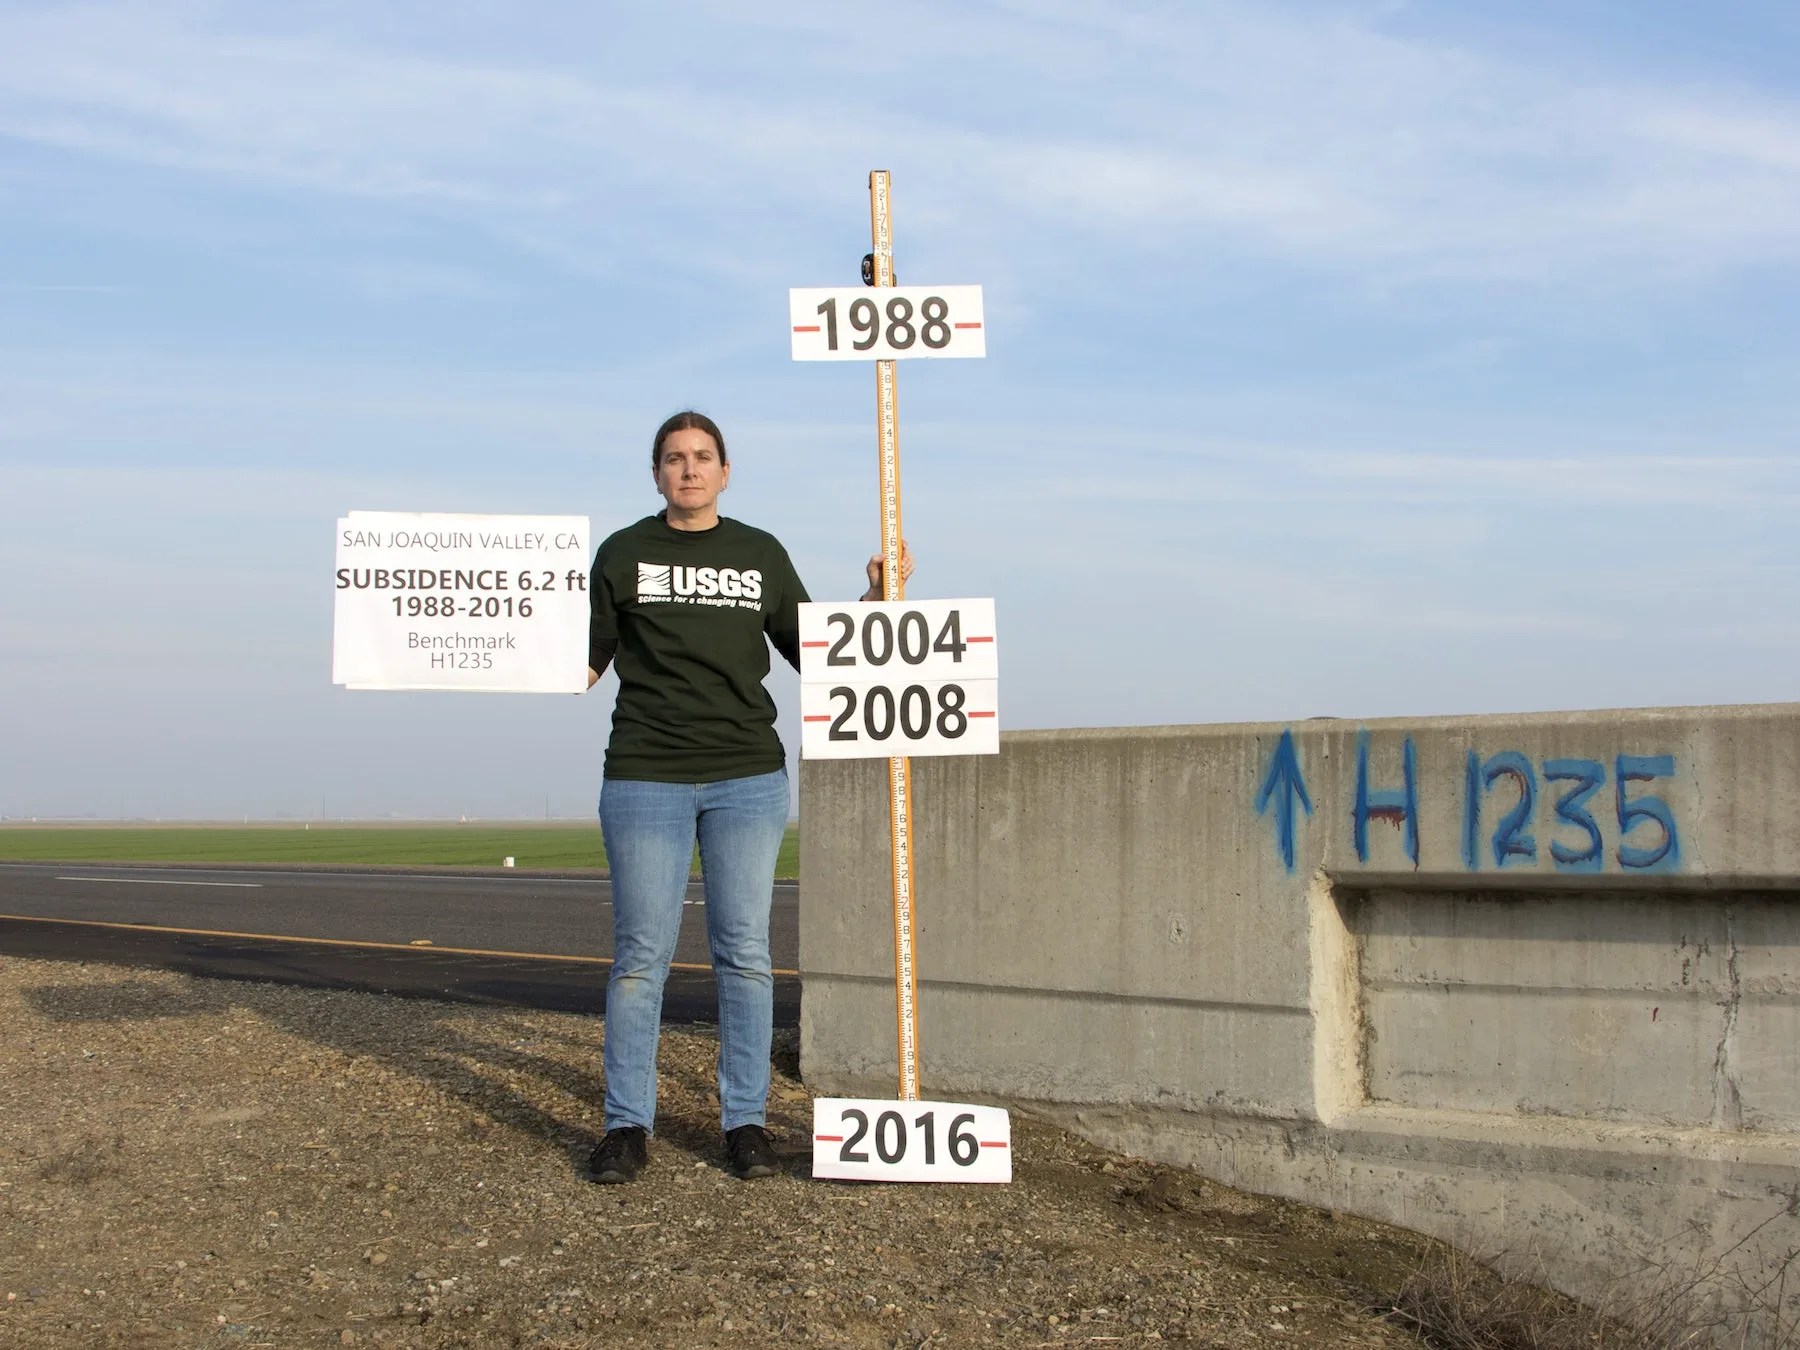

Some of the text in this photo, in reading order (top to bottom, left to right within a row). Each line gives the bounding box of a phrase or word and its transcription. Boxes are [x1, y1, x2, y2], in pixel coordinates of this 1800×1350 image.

[817, 296, 952, 351] 1988
[886, 428, 892, 437] 4
[887, 441, 894, 451] 3
[887, 455, 894, 465] 2
[889, 496, 896, 506] 9
[889, 510, 896, 519] 8
[889, 524, 896, 533] 7
[343, 530, 580, 552] SAN JOAQUIN VALLEY, CA
[890, 538, 897, 547] 6
[890, 551, 897, 560] 5
[891, 565, 897, 574] 4
[336, 568, 587, 591] SUBSIDENCE 6.2 ft
[673, 565, 762, 600] USGS
[392, 595, 533, 618] 1988-2016
[637, 593, 763, 612] science for a changing world
[408, 631, 516, 649] Benchmark
[827, 610, 967, 667] 2004
[431, 652, 493, 669] H1235
[829, 684, 968, 741] 2008
[898, 772, 905, 781] 9
[899, 800, 906, 809] 7
[899, 814, 906, 823] 6
[900, 828, 907, 837] 5
[901, 842, 906, 851] 4
[901, 856, 908, 865] 3
[901, 870, 908, 879] 2
[901, 896, 909, 909] 2
[903, 912, 910, 920] 9
[903, 926, 910, 935] 8
[904, 940, 910, 949] 7
[904, 953, 911, 962] 6
[905, 967, 911, 976] 5
[905, 981, 911, 990] 4
[905, 995, 912, 1004] 3
[906, 1009, 913, 1018] 2
[908, 1065, 915, 1074] 8
[908, 1079, 915, 1087] 7
[839, 1108, 980, 1167] 2016
